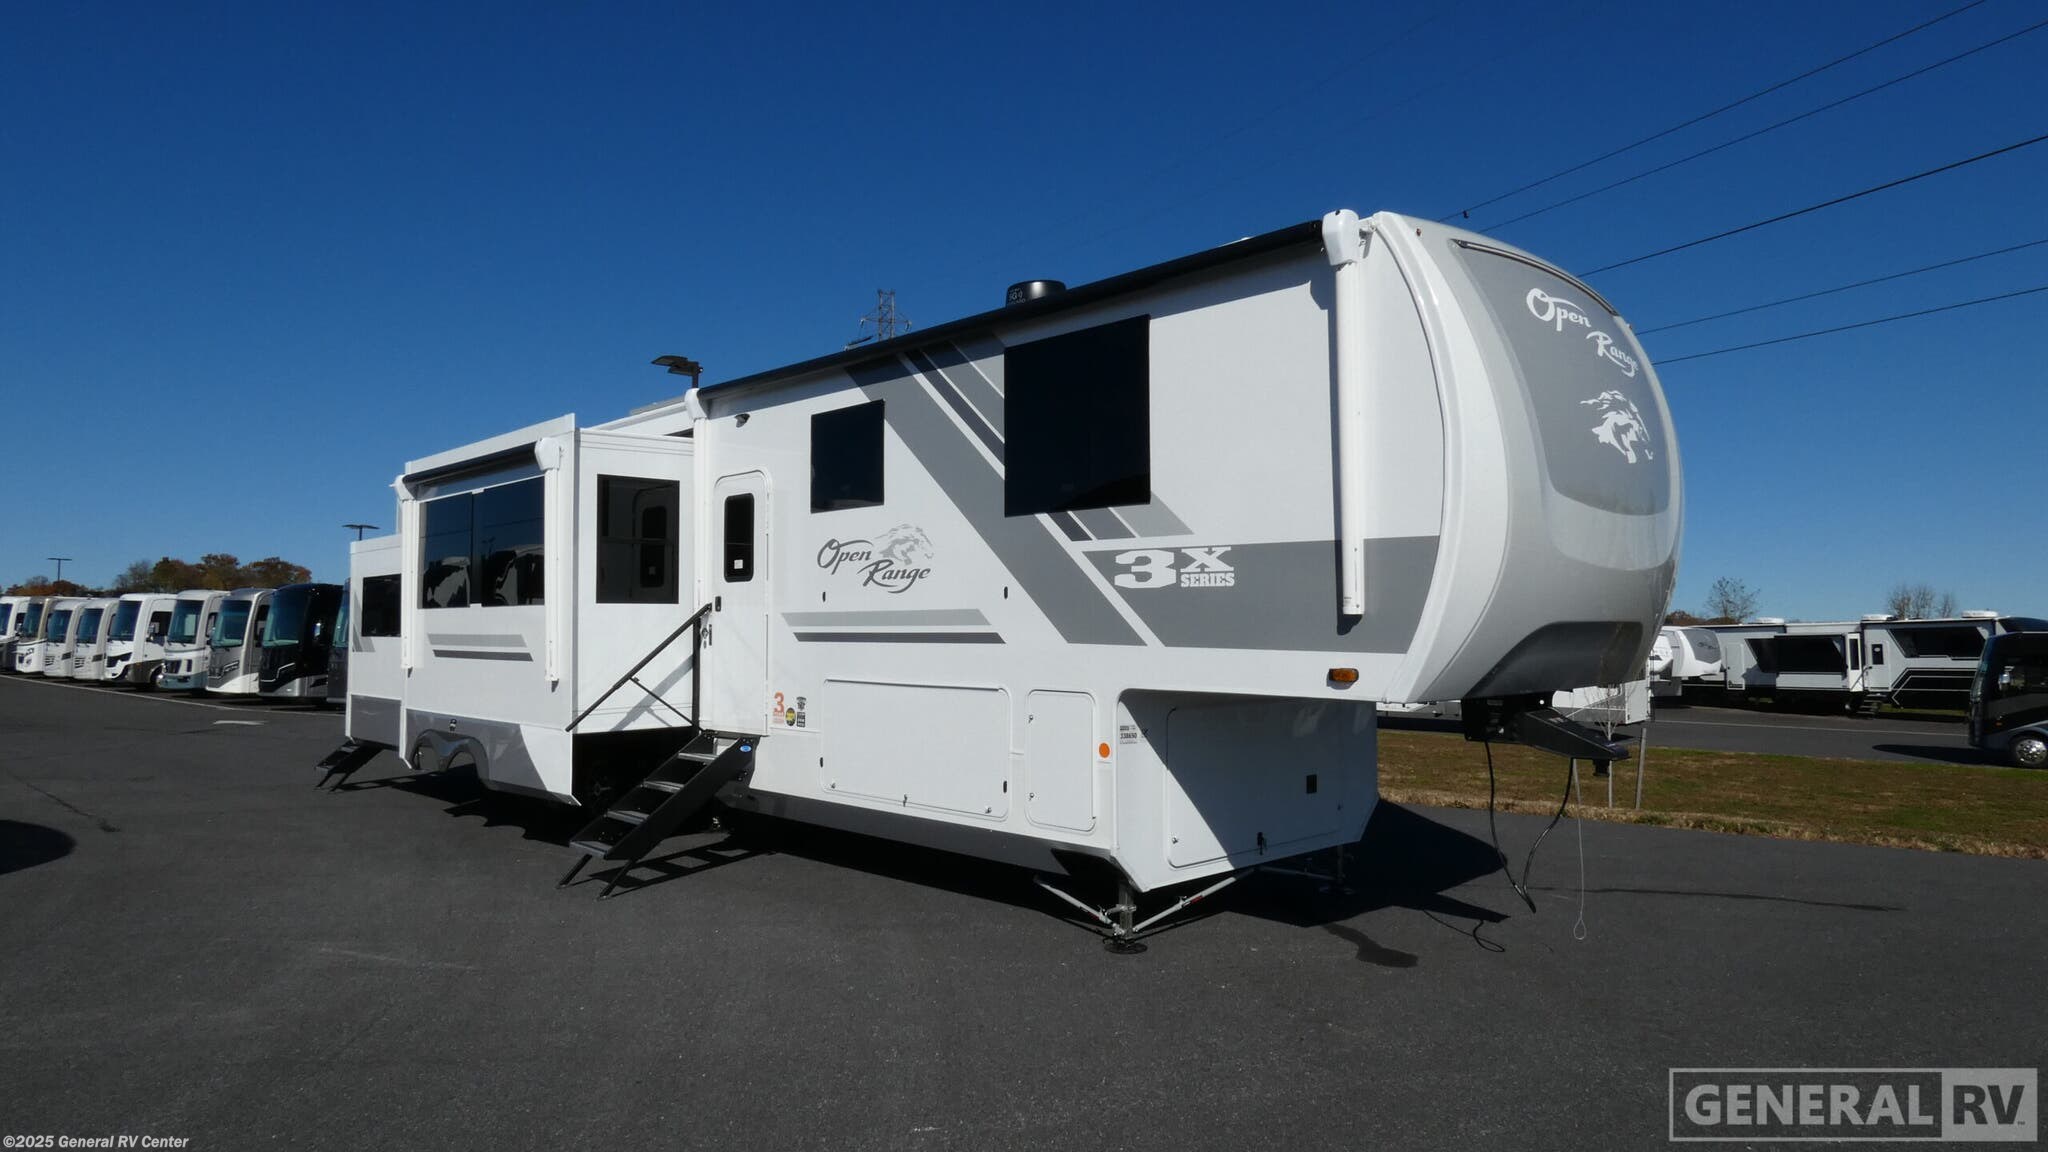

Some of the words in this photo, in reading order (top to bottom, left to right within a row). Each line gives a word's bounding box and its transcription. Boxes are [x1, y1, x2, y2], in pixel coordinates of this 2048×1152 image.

[1526, 287, 1592, 332] Open
[1585, 330, 1639, 378] Range
[817, 538, 874, 575] Open
[856, 559, 931, 594] Range
[1180, 572, 1235, 588] SERIES
